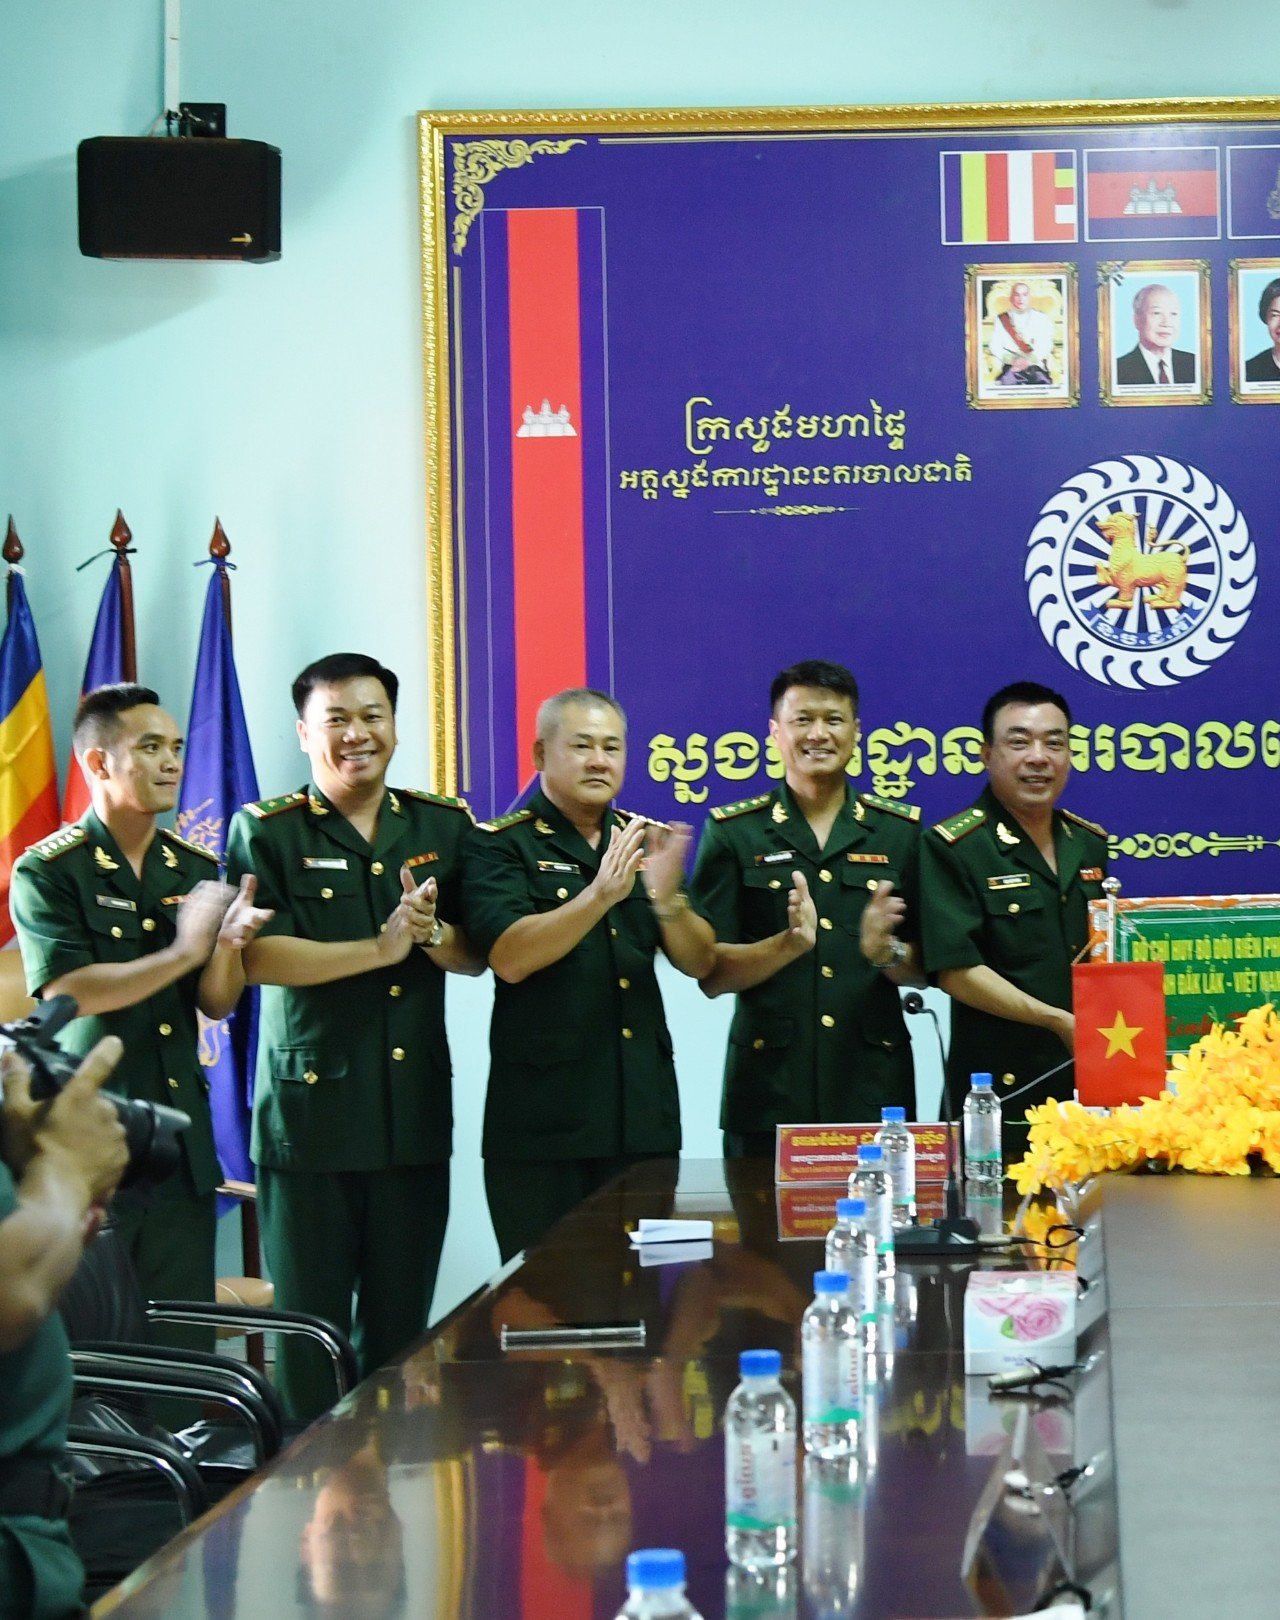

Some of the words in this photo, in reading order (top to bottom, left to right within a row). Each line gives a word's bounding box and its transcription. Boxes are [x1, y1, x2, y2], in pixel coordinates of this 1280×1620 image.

[685, 396, 907, 454] ក្រសួងមហាផ្ទៃ
[619, 453, 974, 500] អគ្គស្នងការដ្ឋាននគរបាលជាតិ
